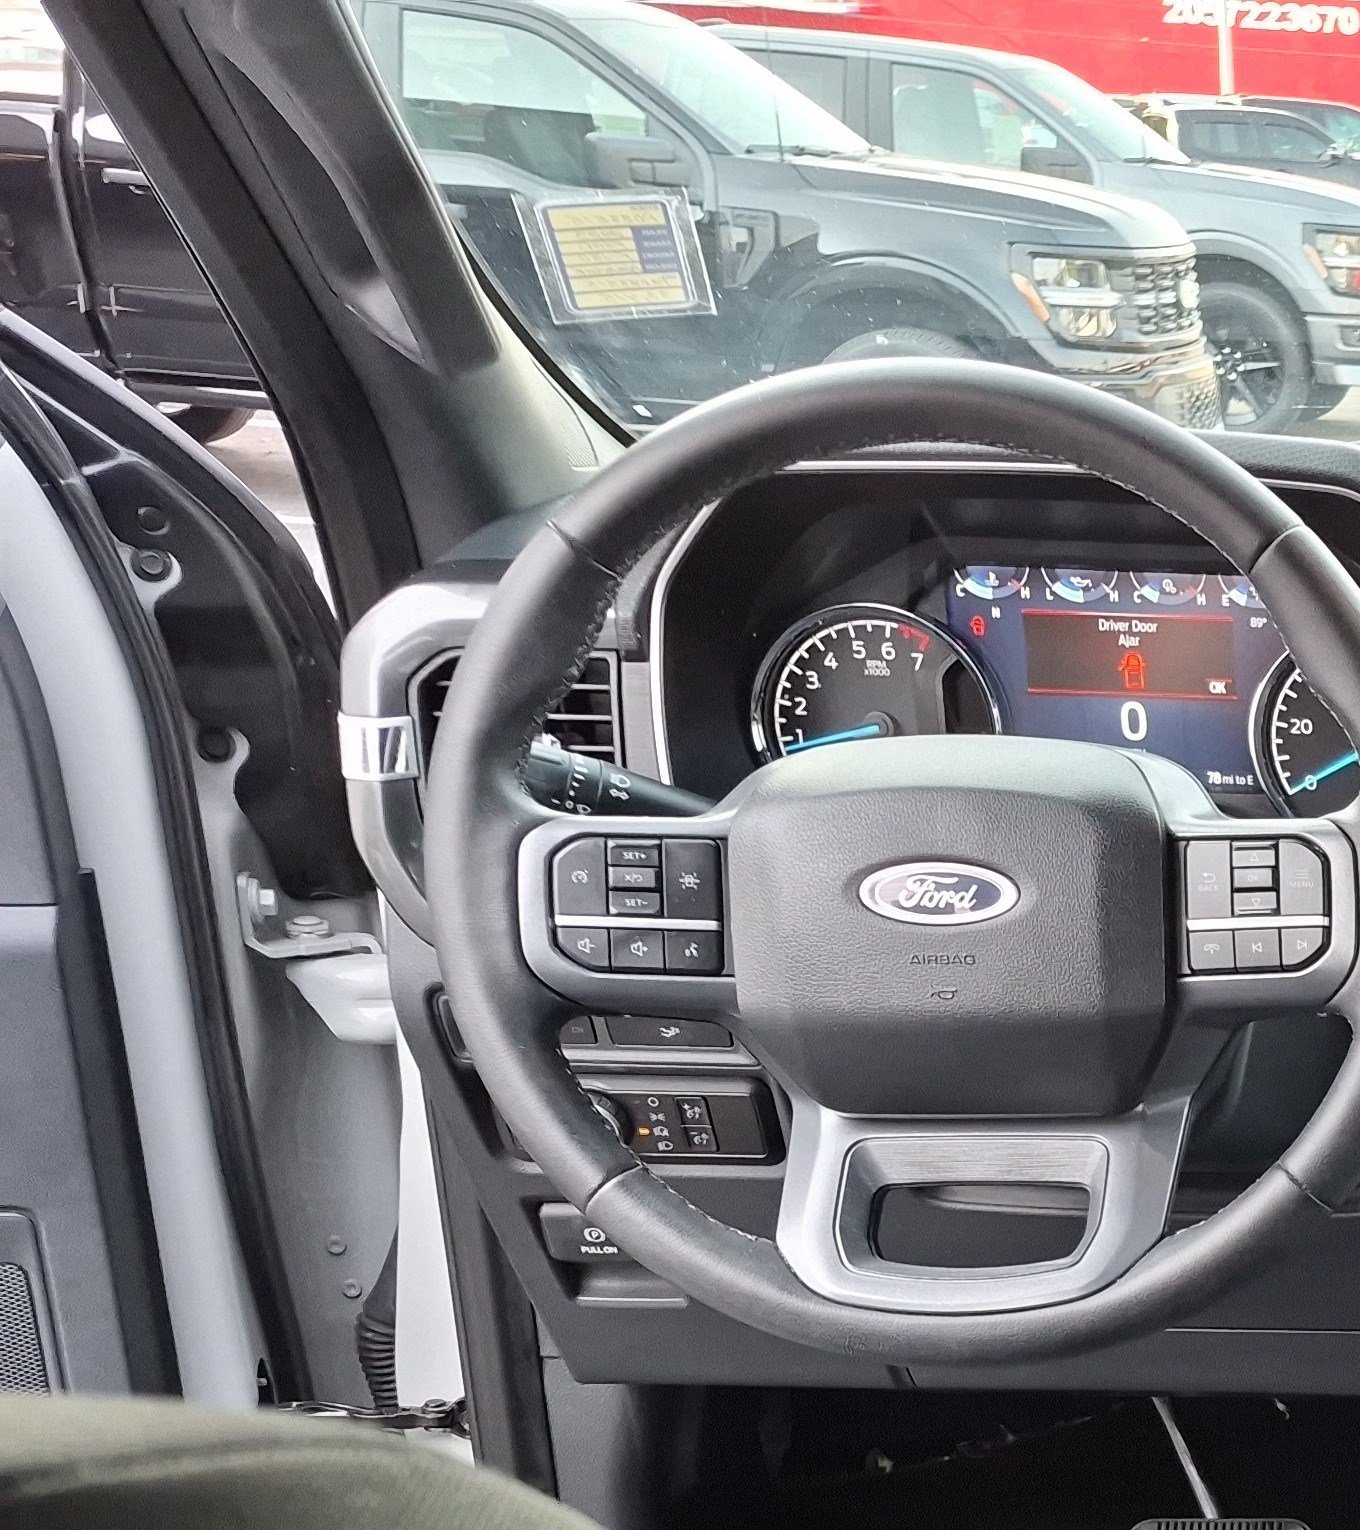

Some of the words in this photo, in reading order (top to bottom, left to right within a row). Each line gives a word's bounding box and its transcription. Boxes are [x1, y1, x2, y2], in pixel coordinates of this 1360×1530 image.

[991, 606, 1001, 619] N
[1098, 618, 1129, 633] Driver
[1131, 619, 1158, 633] Door
[1118, 634, 1140, 648] Ajar
[852, 640, 866, 659] 5
[881, 641, 896, 660] 6
[823, 652, 839, 670] 4
[866, 660, 887, 668] RPM
[911, 653, 924, 671] 7
[806, 671, 819, 689] 3
[1209, 681, 1227, 695] OK
[794, 697, 808, 716] 2
[1120, 701, 1149, 742] 0
[1289, 718, 1313, 735] 20
[1235, 774, 1246, 785] to
[1305, 775, 1317, 791] 0
[899, 874, 979, 909] Ford
[1290, 881, 1314, 889] MENU
[909, 954, 976, 966] AIRBAG
